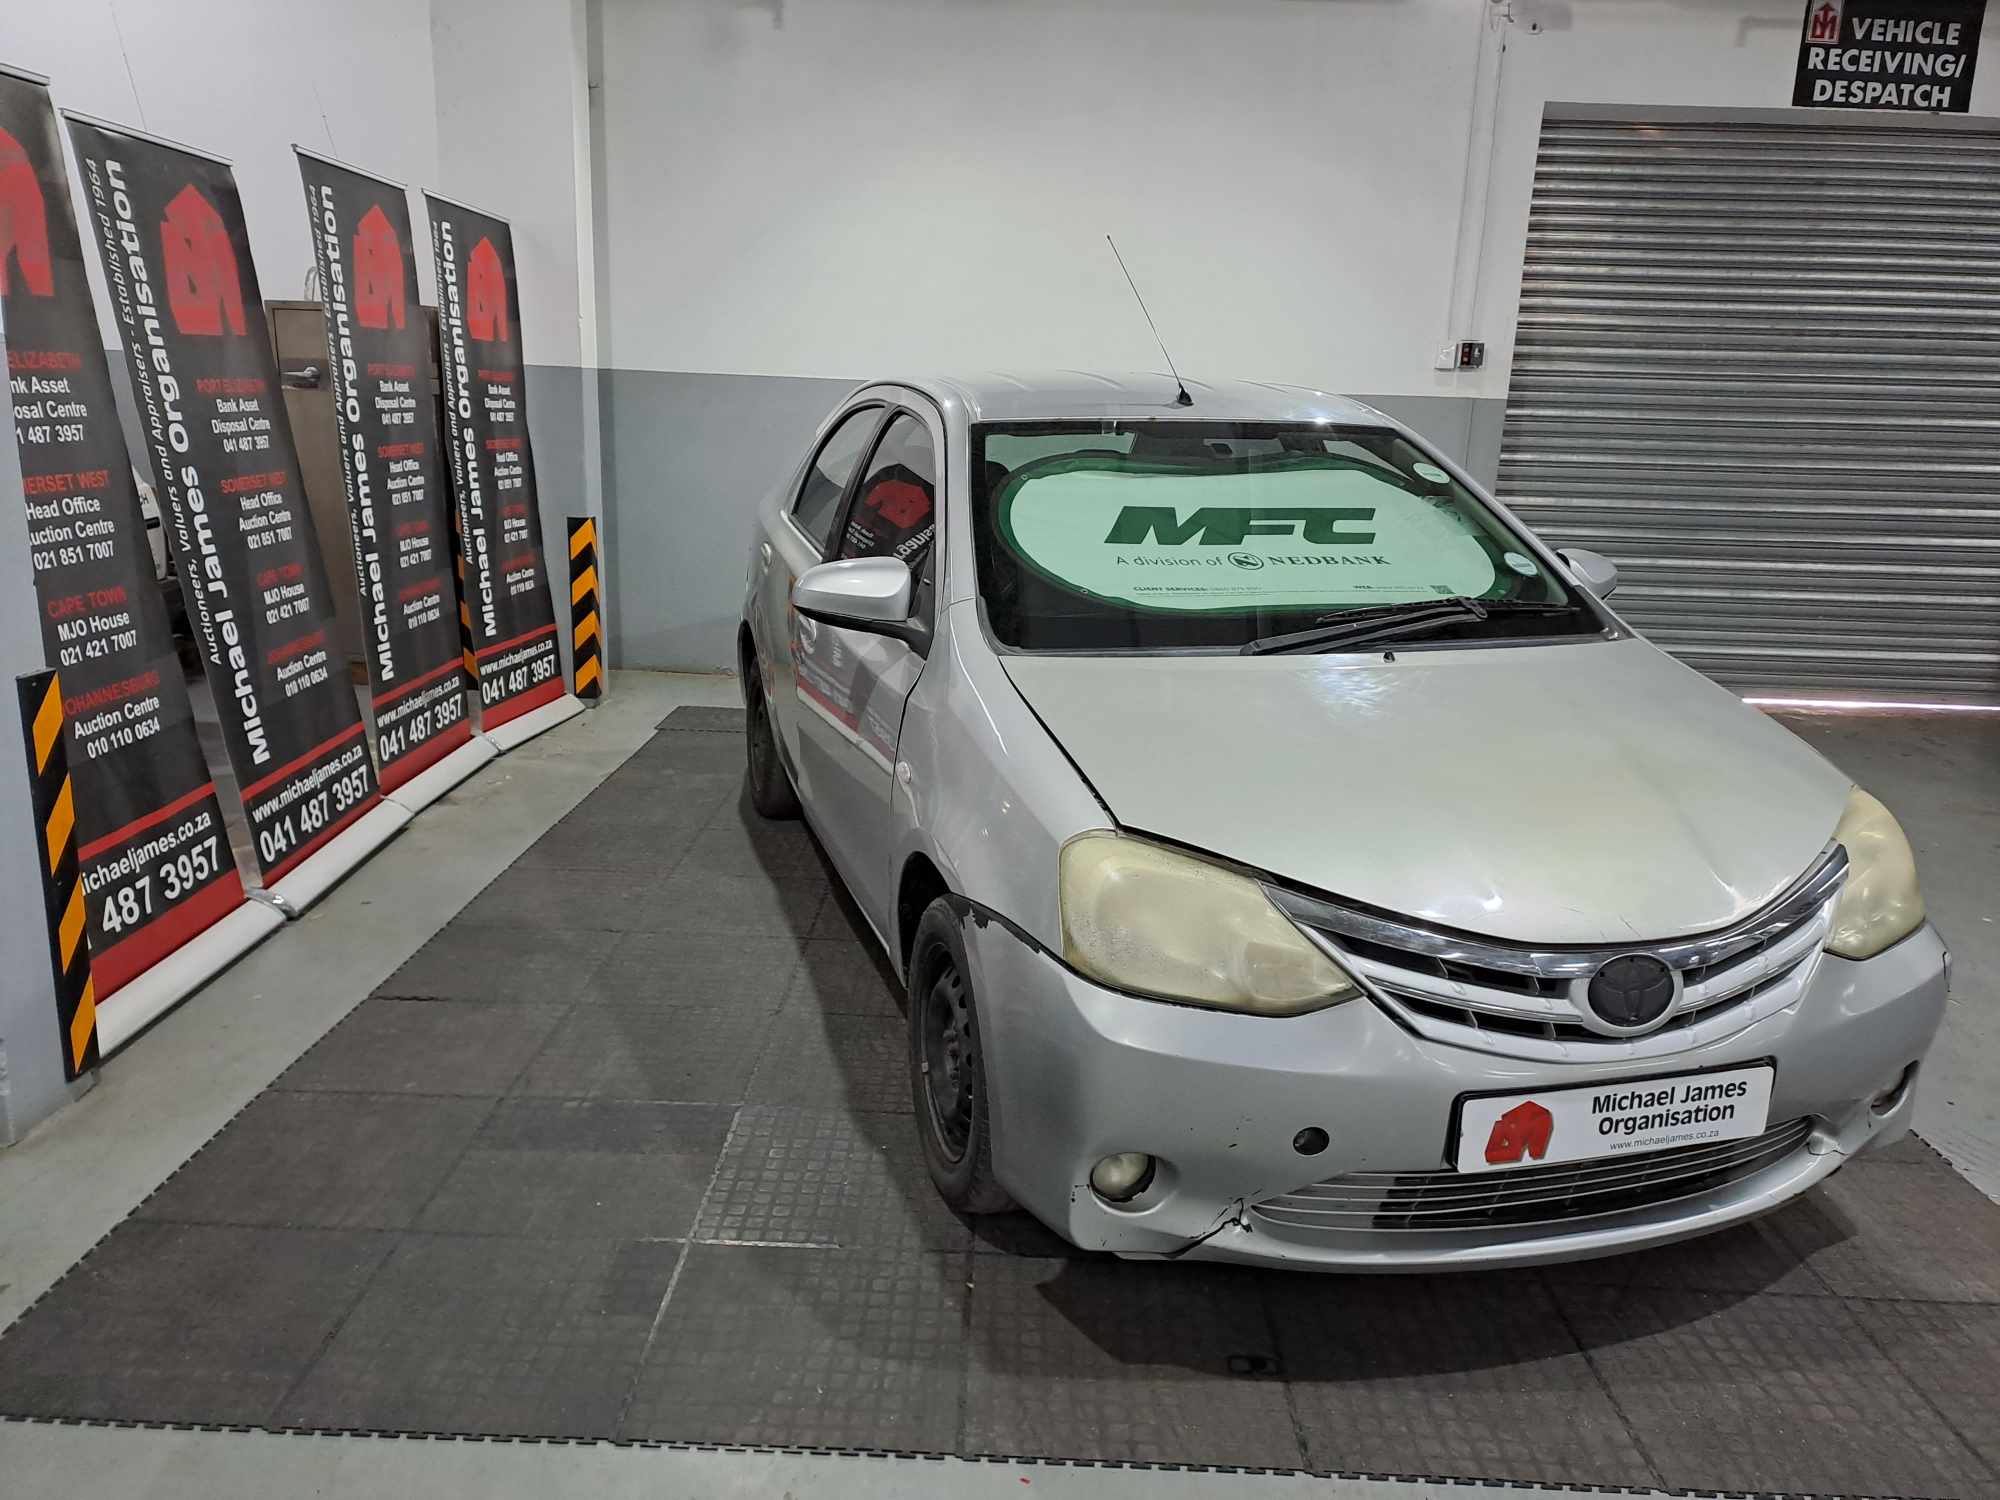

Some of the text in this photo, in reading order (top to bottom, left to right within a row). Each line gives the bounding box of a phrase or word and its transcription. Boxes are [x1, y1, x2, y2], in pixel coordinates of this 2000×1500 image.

[1852, 17, 1962, 46] VEHICLE
[1807, 46, 1967, 78] RECEIVING/
[1813, 79, 1951, 108] DESPATCH
[31, 376, 70, 393] Asset
[46, 401, 87, 417] Centre
[85, 158, 222, 665] Auctioneers, Valuers and Appraisers Established 1964
[448, 410, 458, 435] and
[28, 426, 51, 443] 487
[55, 424, 84, 442] 3957
[211, 419, 248, 435] Disposal
[321, 186, 394, 681] Michael James Organisation
[337, 415, 347, 444] and
[441, 221, 497, 637] Michael James Organisation
[106, 160, 271, 765] Michael James Organisation
[223, 439, 238, 453] 041
[343, 449, 354, 502] Valuers
[26, 497, 100, 520] Head Office
[1103, 505, 1377, 546] MFC
[31, 520, 115, 545] uction Centre
[34, 541, 113, 570] 021 851 7007
[1117, 555, 1393, 567] A division of NEDBANK
[58, 612, 129, 641] MJO House
[60, 630, 137, 666] 021 421 7007
[482, 654, 555, 705] 041 487 3957
[74, 696, 159, 739] Auction Centre
[380, 693, 462, 761] 041 487 3957
[87, 716, 160, 759] 010 110 0634
[252, 745, 363, 823] www.michaeljames.co.za
[260, 764, 369, 862] 041 487 3957
[81, 812, 211, 896] ichaeljames.co.za
[102, 836, 218, 933] 487 3957
[1592, 1079, 1748, 1115] Michael James
[1598, 1101, 1735, 1136] Organisation
[1609, 1128, 1720, 1151] www.michaeljames.co.za
